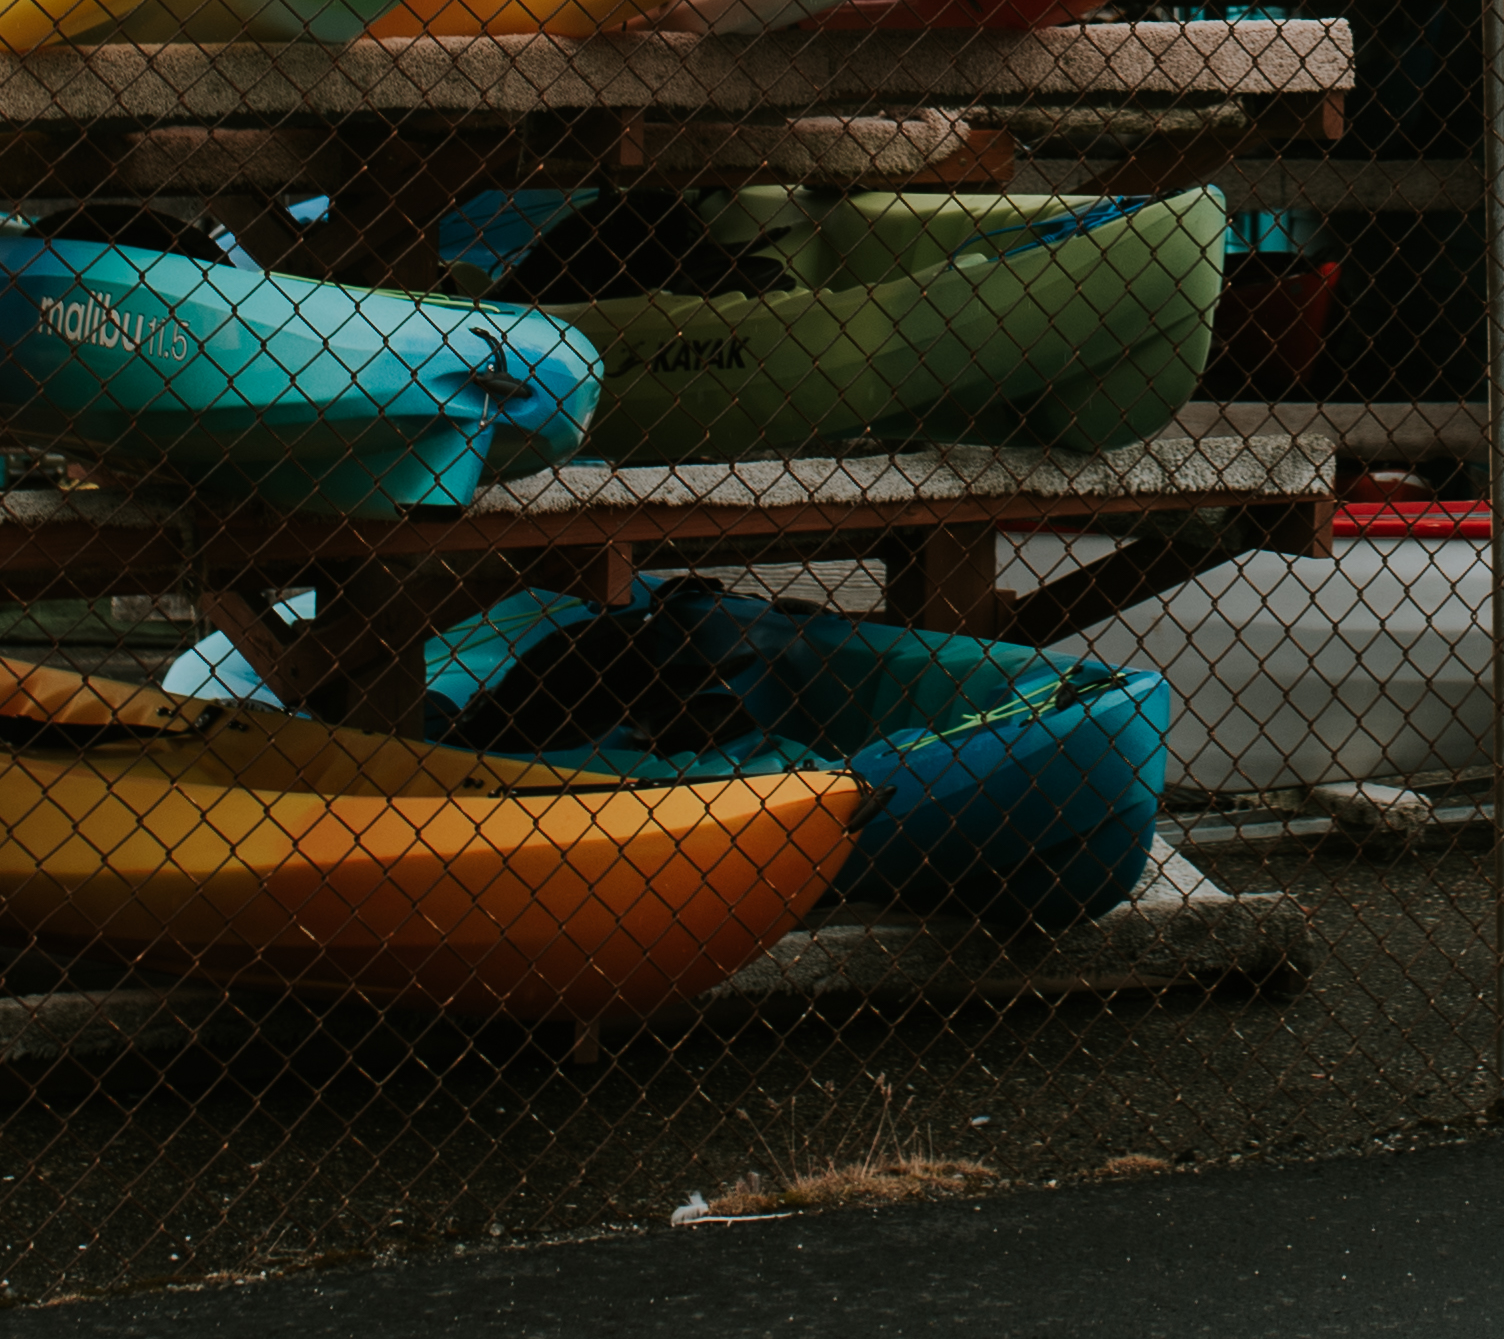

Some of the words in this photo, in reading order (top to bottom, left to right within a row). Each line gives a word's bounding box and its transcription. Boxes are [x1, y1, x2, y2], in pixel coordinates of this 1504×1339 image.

[36, 290, 144, 353] malibu
[147, 316, 190, 362] 11.5
[653, 336, 751, 373] KAYAK
